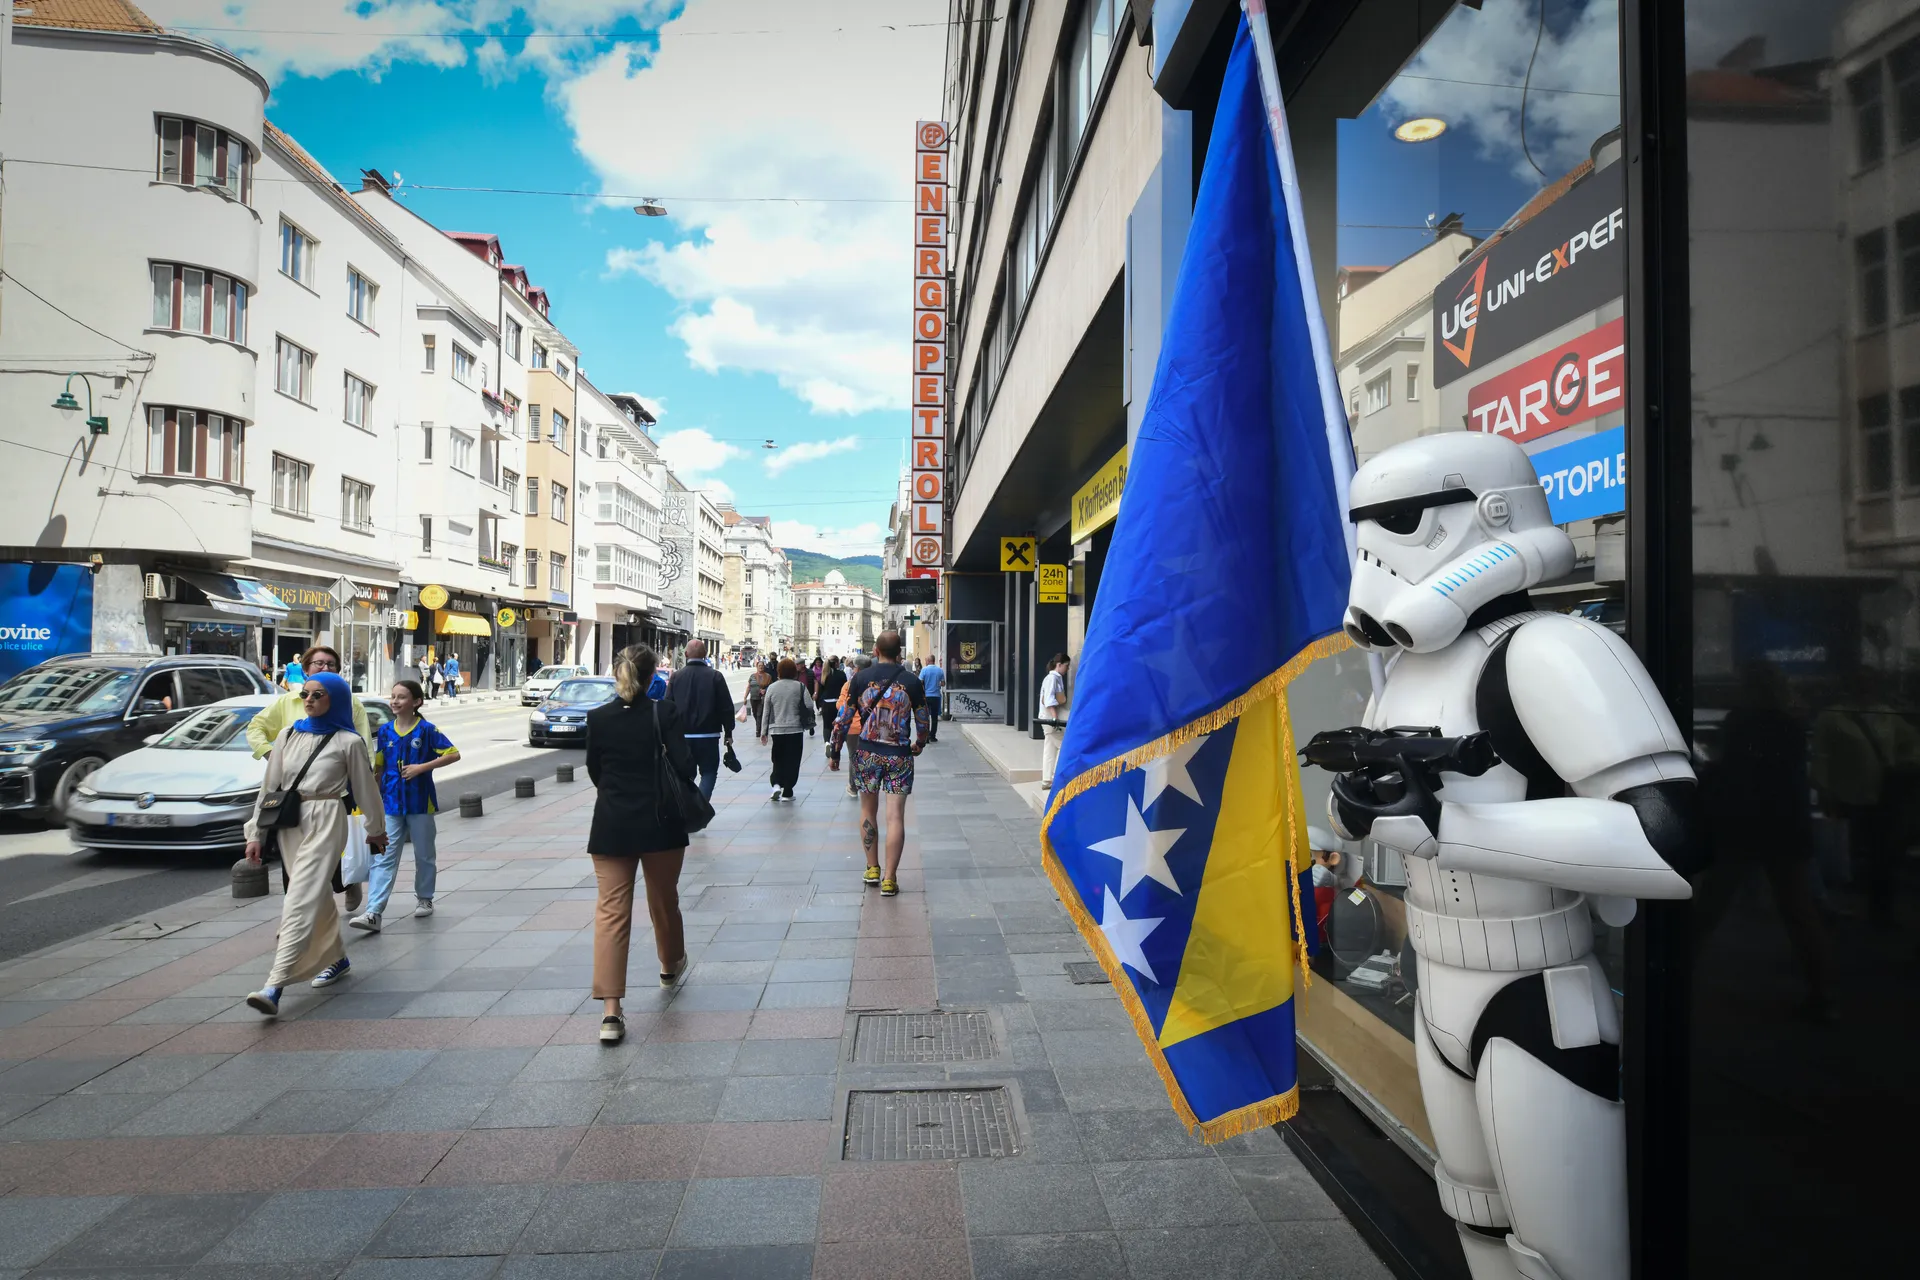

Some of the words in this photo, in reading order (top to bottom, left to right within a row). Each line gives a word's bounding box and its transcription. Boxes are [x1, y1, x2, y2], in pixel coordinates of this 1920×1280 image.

[1441, 292, 1478, 340] UE
[916, 155, 943, 532] ENERGOPETROL
[1085, 477, 1118, 523] Raiffeisen
[1042, 568, 1064, 579] 24h
[452, 600, 477, 613] PEKARA
[0, 623, 51, 640] ovine
[4, 641, 20, 651] lice
[21, 641, 43, 651] ulice
